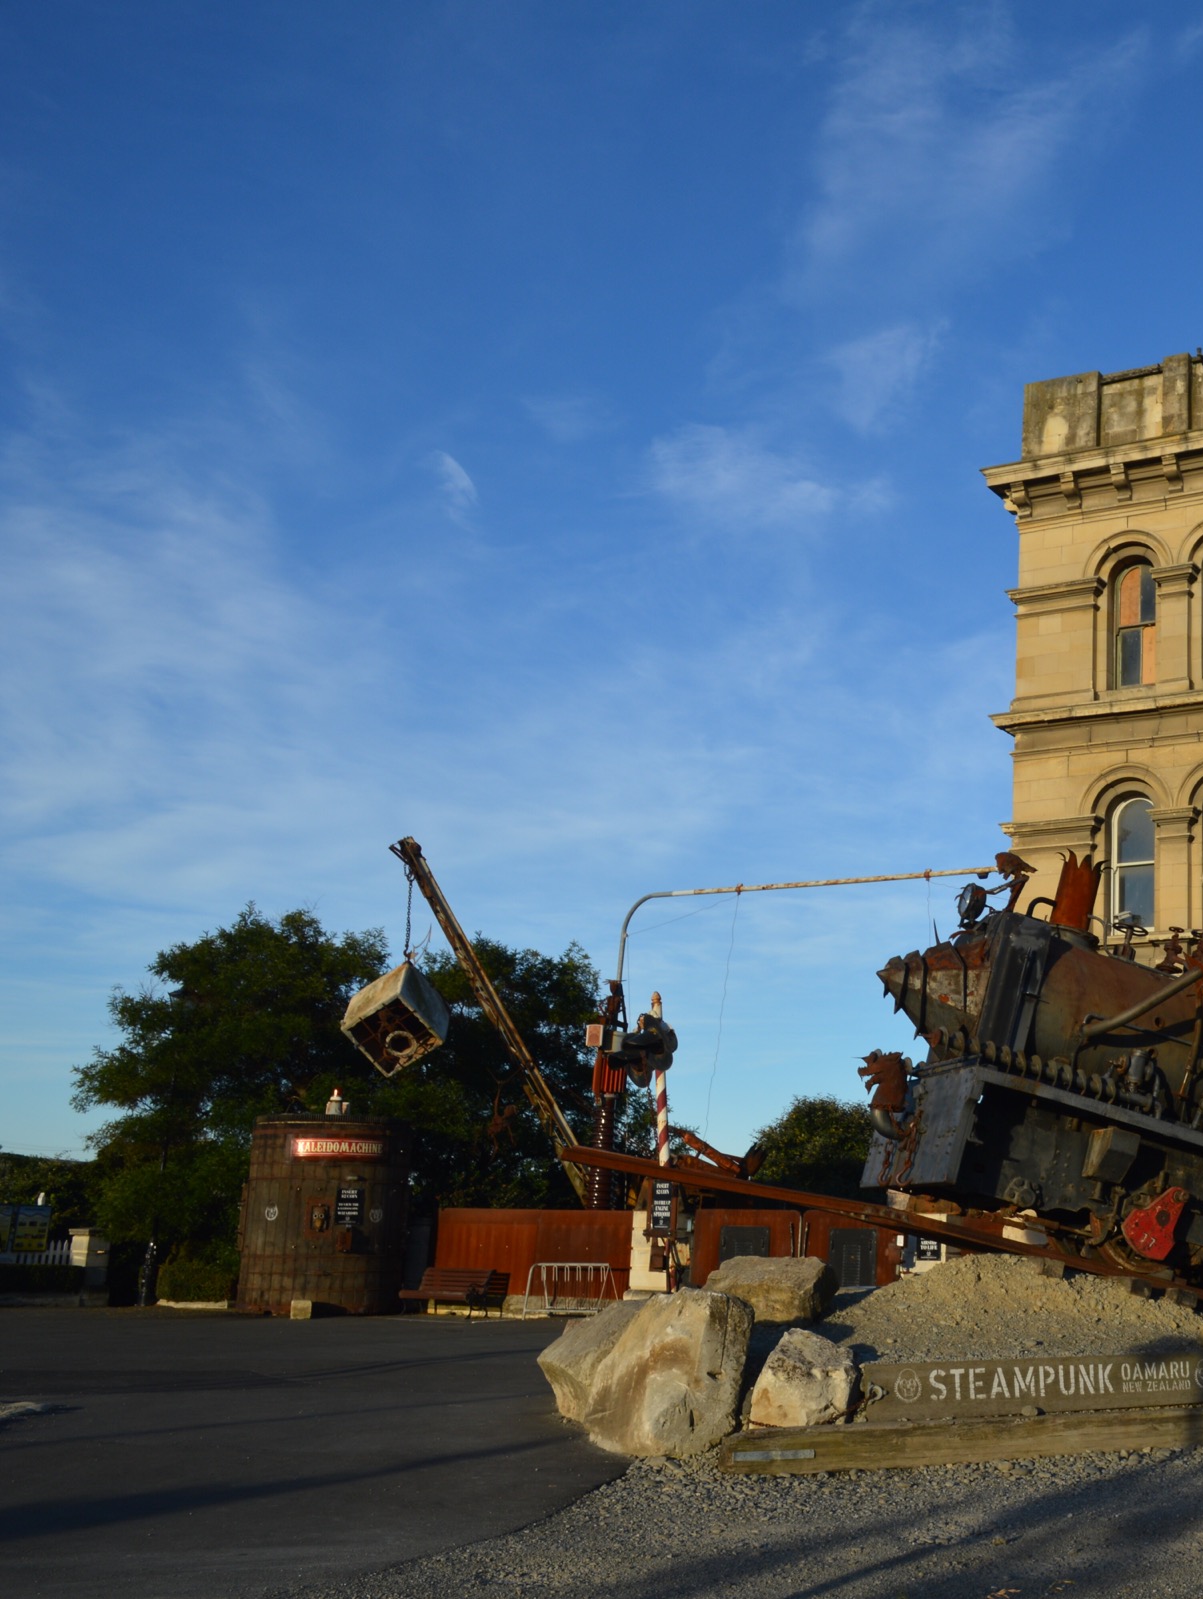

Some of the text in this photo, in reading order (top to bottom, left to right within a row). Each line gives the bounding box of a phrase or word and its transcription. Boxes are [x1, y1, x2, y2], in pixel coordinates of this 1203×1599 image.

[296, 1141, 384, 1154] KALEIDOMACHINE
[1120, 1360, 1191, 1381] OAMARU
[928, 1363, 1115, 1401] STEAMPUNK
[1122, 1379, 1191, 1393] NEW ZEALAND
